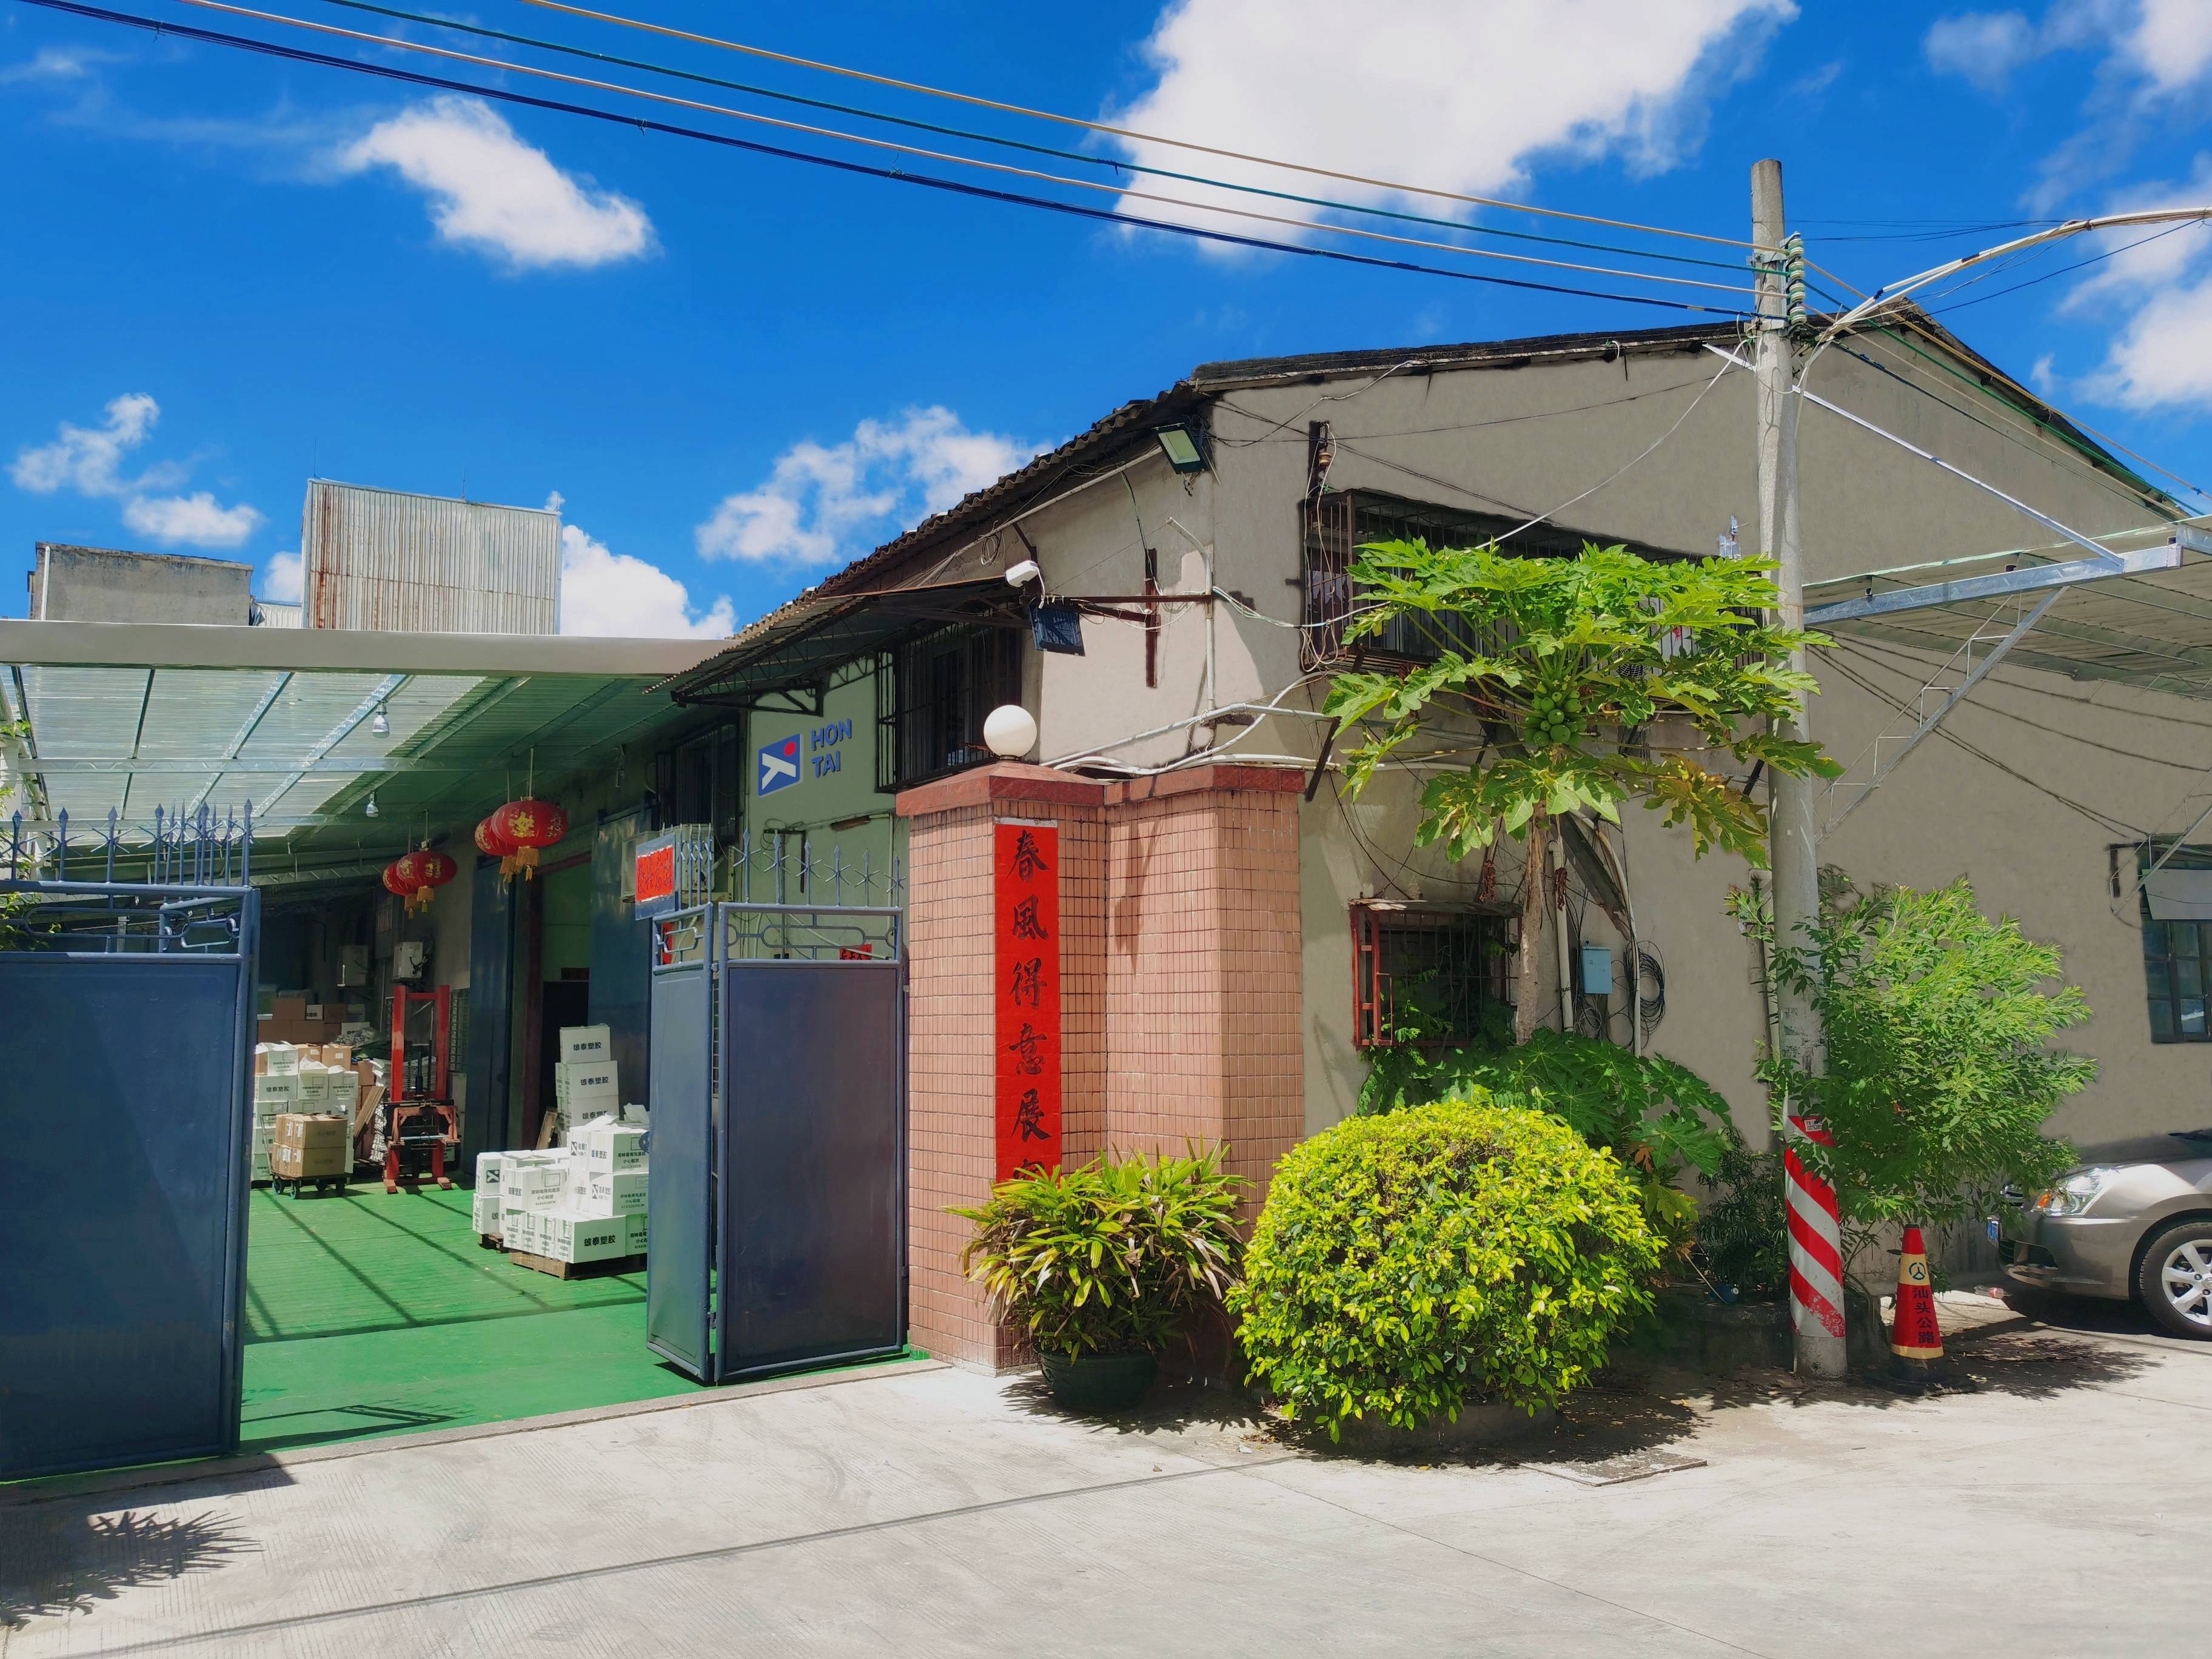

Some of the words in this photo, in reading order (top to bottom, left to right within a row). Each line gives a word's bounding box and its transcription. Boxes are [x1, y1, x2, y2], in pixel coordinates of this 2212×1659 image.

[811, 719, 851, 751] HON
[811, 751, 840, 778] TAI
[1912, 1287, 1935, 1344] 汕头公路
